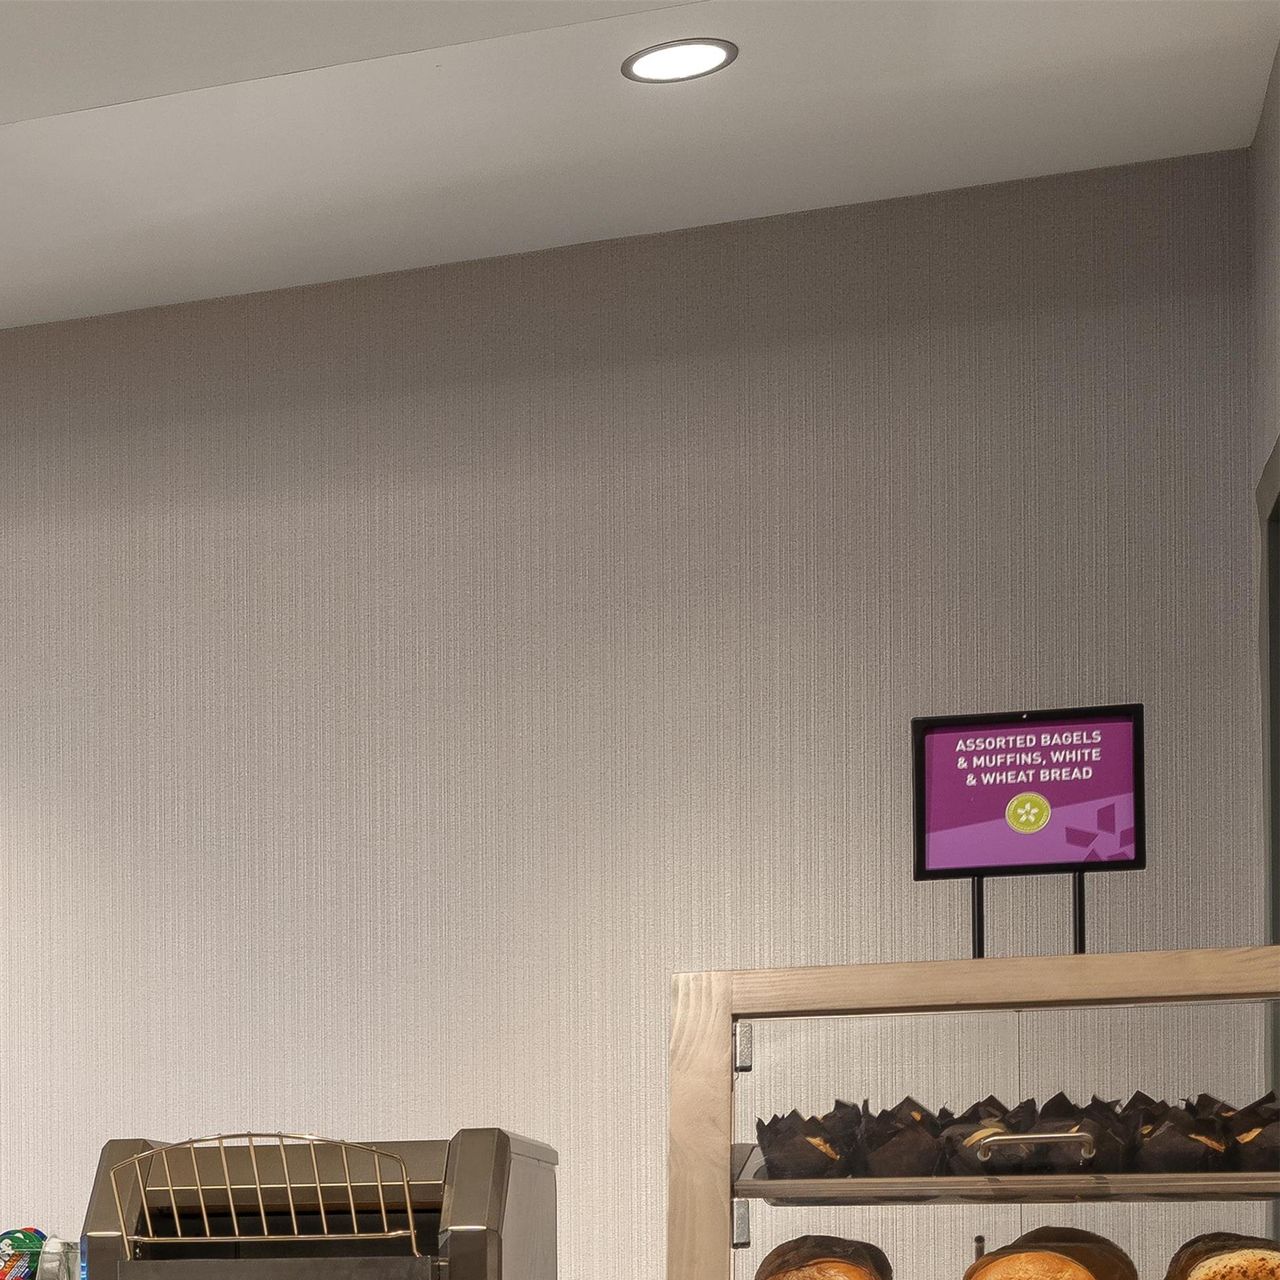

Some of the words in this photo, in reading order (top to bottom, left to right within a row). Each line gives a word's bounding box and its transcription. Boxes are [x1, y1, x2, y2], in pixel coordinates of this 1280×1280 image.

[955, 734, 1036, 752] ASSORTED
[1041, 730, 1102, 747] BAGELS
[957, 756, 968, 769] &
[972, 752, 1046, 768] MUFFINS,
[1050, 748, 1101, 763] WHITE
[966, 773, 977, 786] &
[981, 770, 1035, 785] WHEAT
[1040, 766, 1093, 782] BREAD
